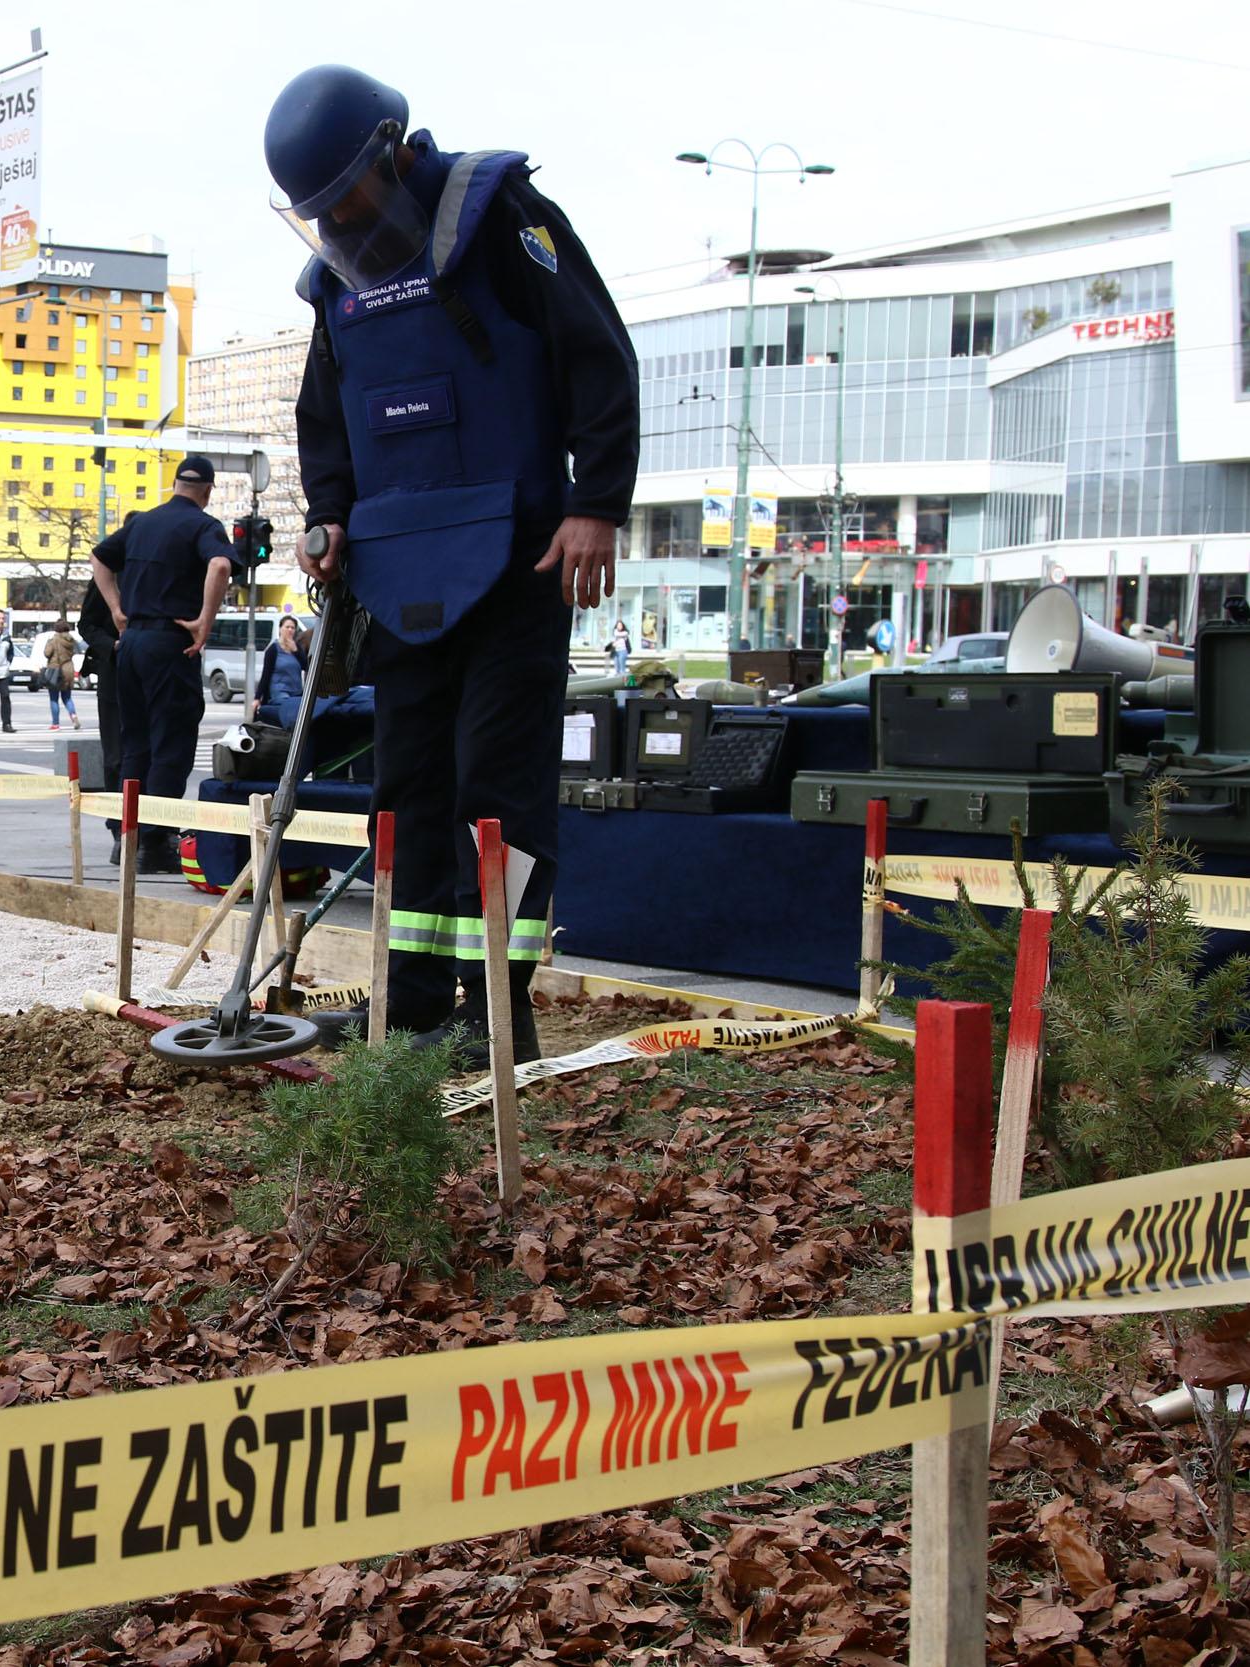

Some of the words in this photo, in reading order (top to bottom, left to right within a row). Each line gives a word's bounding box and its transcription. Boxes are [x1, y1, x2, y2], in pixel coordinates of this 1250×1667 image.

[38, 259, 95, 278] OLIDAY
[358, 283, 400, 301] FEDERALNA
[365, 295, 394, 309] CIVILNE
[396, 286, 430, 301] ZAŠTITE
[304, 988, 366, 1008] DERALNA
[664, 1029, 701, 1050] PAZI
[925, 1217, 1101, 1314] UPRAVA
[1103, 1187, 1250, 1298] CIVILNE
[120, 1385, 409, 1559] ZAŠTITE
[451, 1370, 590, 1503] PAZI
[601, 1350, 752, 1471] MINE
